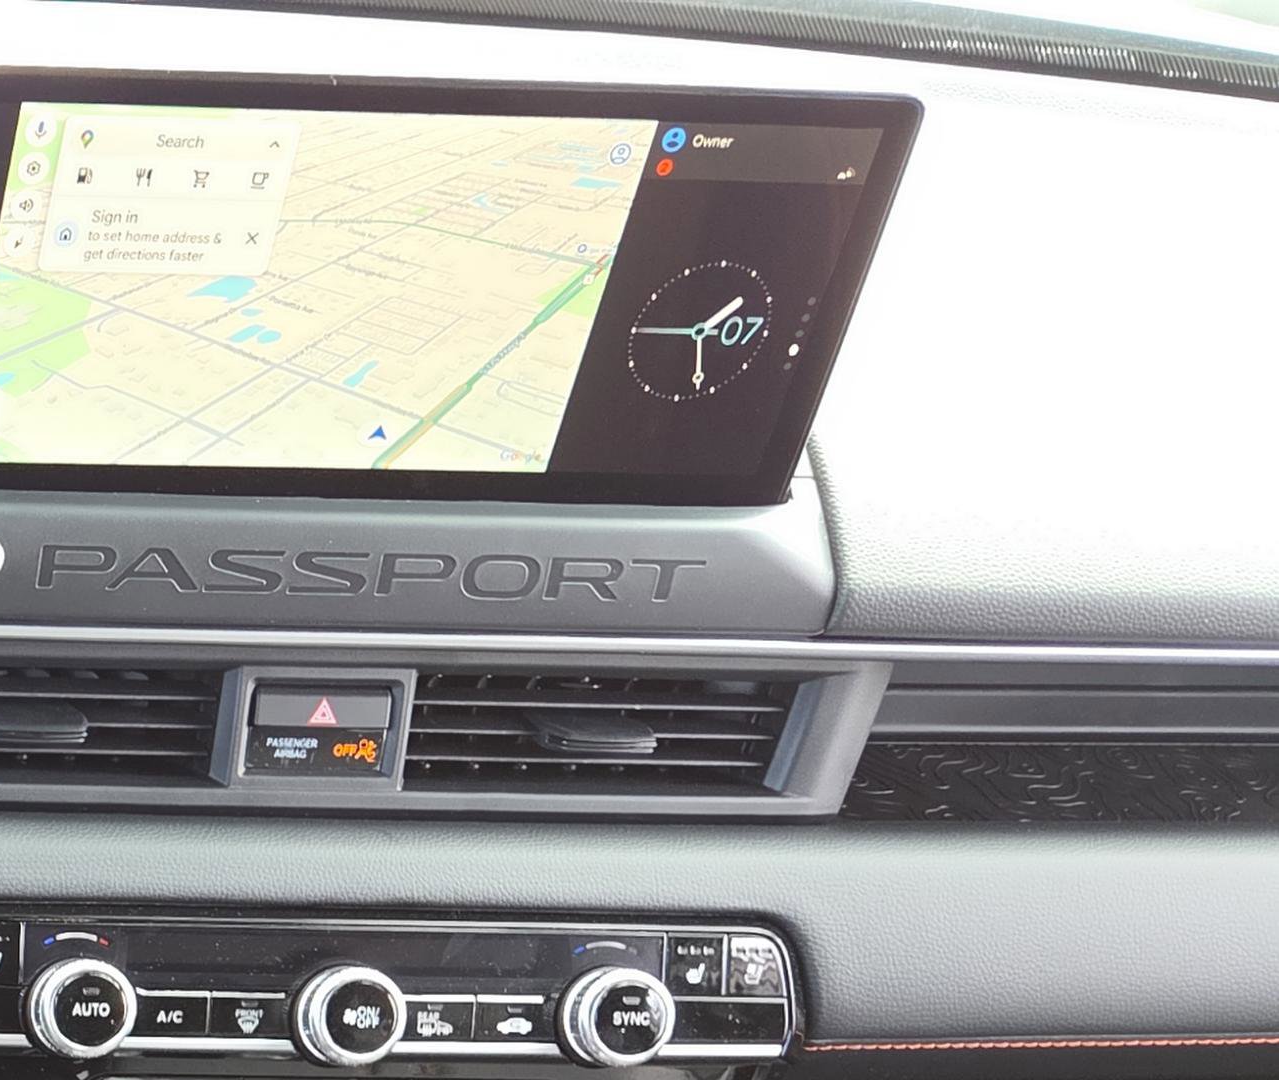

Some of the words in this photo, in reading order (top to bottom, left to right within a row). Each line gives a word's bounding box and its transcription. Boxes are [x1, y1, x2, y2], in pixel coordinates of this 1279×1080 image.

[156, 134, 205, 149] Search
[692, 133, 735, 148] Owner
[91, 210, 122, 226] Sign
[125, 212, 138, 223] in
[88, 231, 100, 241] to
[103, 230, 123, 241] set
[125, 231, 159, 243] home
[162, 232, 210, 244] address
[213, 233, 222, 244] &
[83, 250, 103, 262] get
[106, 248, 166, 261] directions
[169, 249, 204, 262] faster
[720, 316, 764, 346] 07
[35, 545, 707, 602] PASSPORT
[266, 737, 318, 749] PASSENGER
[333, 743, 357, 757] OFF
[274, 749, 307, 759] AIRBAG
[72, 1002, 110, 1017] AUTO
[235, 1009, 263, 1019] FRONT
[417, 1011, 440, 1021] REAR
[156, 1010, 183, 1024] A/C
[613, 1011, 650, 1026] SYNC
